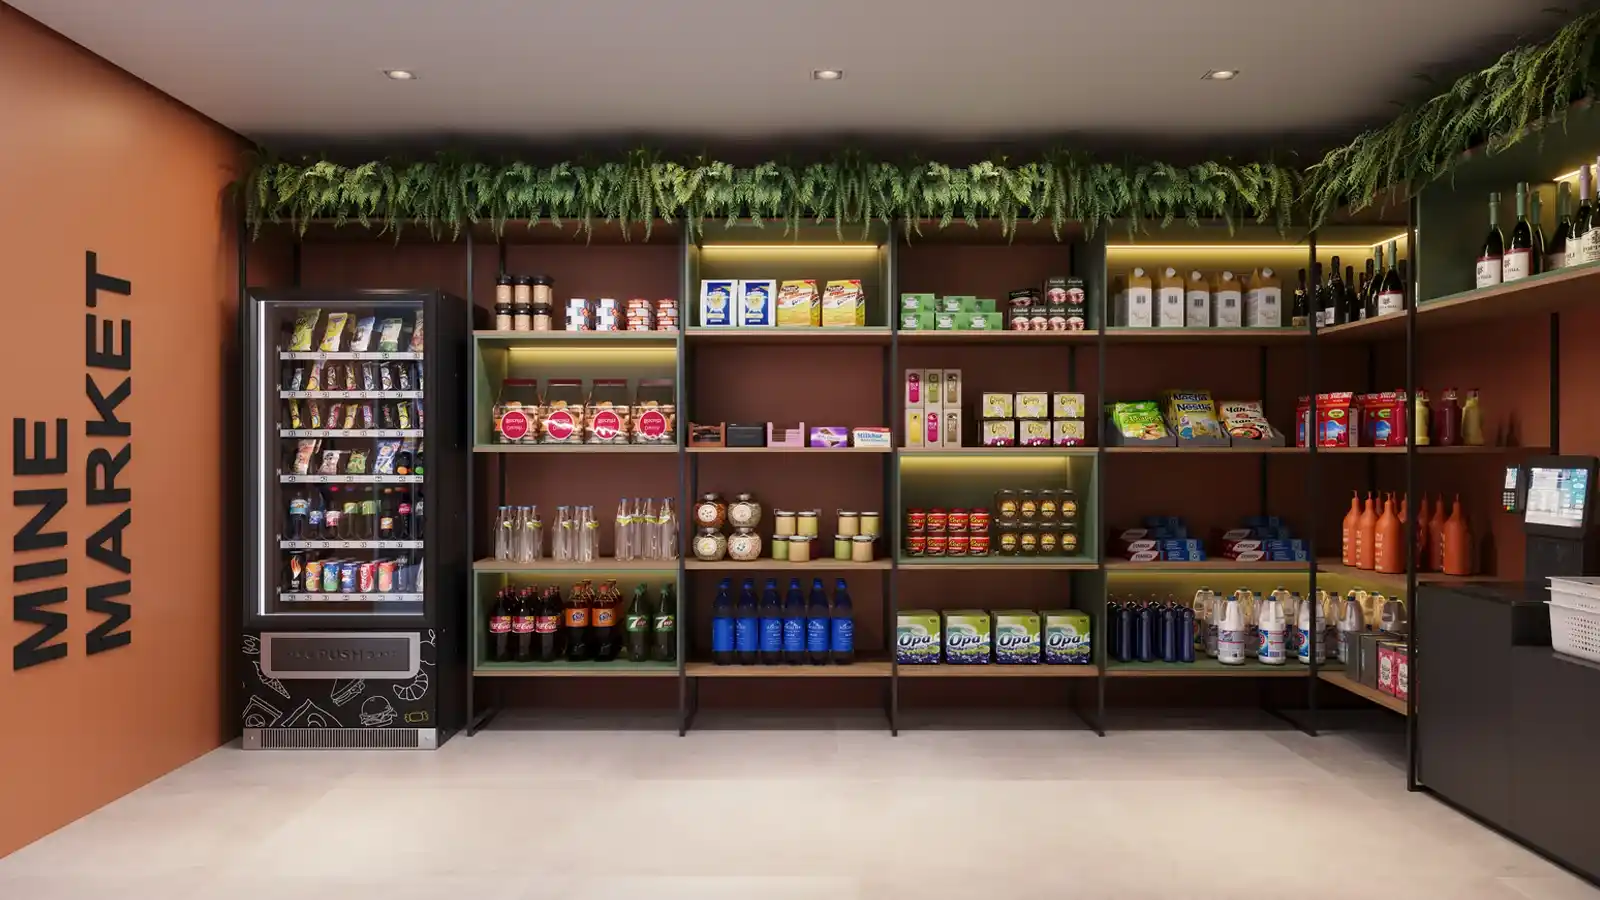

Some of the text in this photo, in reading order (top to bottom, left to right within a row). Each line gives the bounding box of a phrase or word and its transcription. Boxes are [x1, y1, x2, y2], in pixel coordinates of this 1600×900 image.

[86, 250, 131, 657] MARKET
[14, 417, 67, 671] MINE
[900, 633, 931, 646] Opa
[950, 633, 981, 646] Opa
[1000, 633, 1031, 646] Opa
[1050, 633, 1081, 646] Opa
